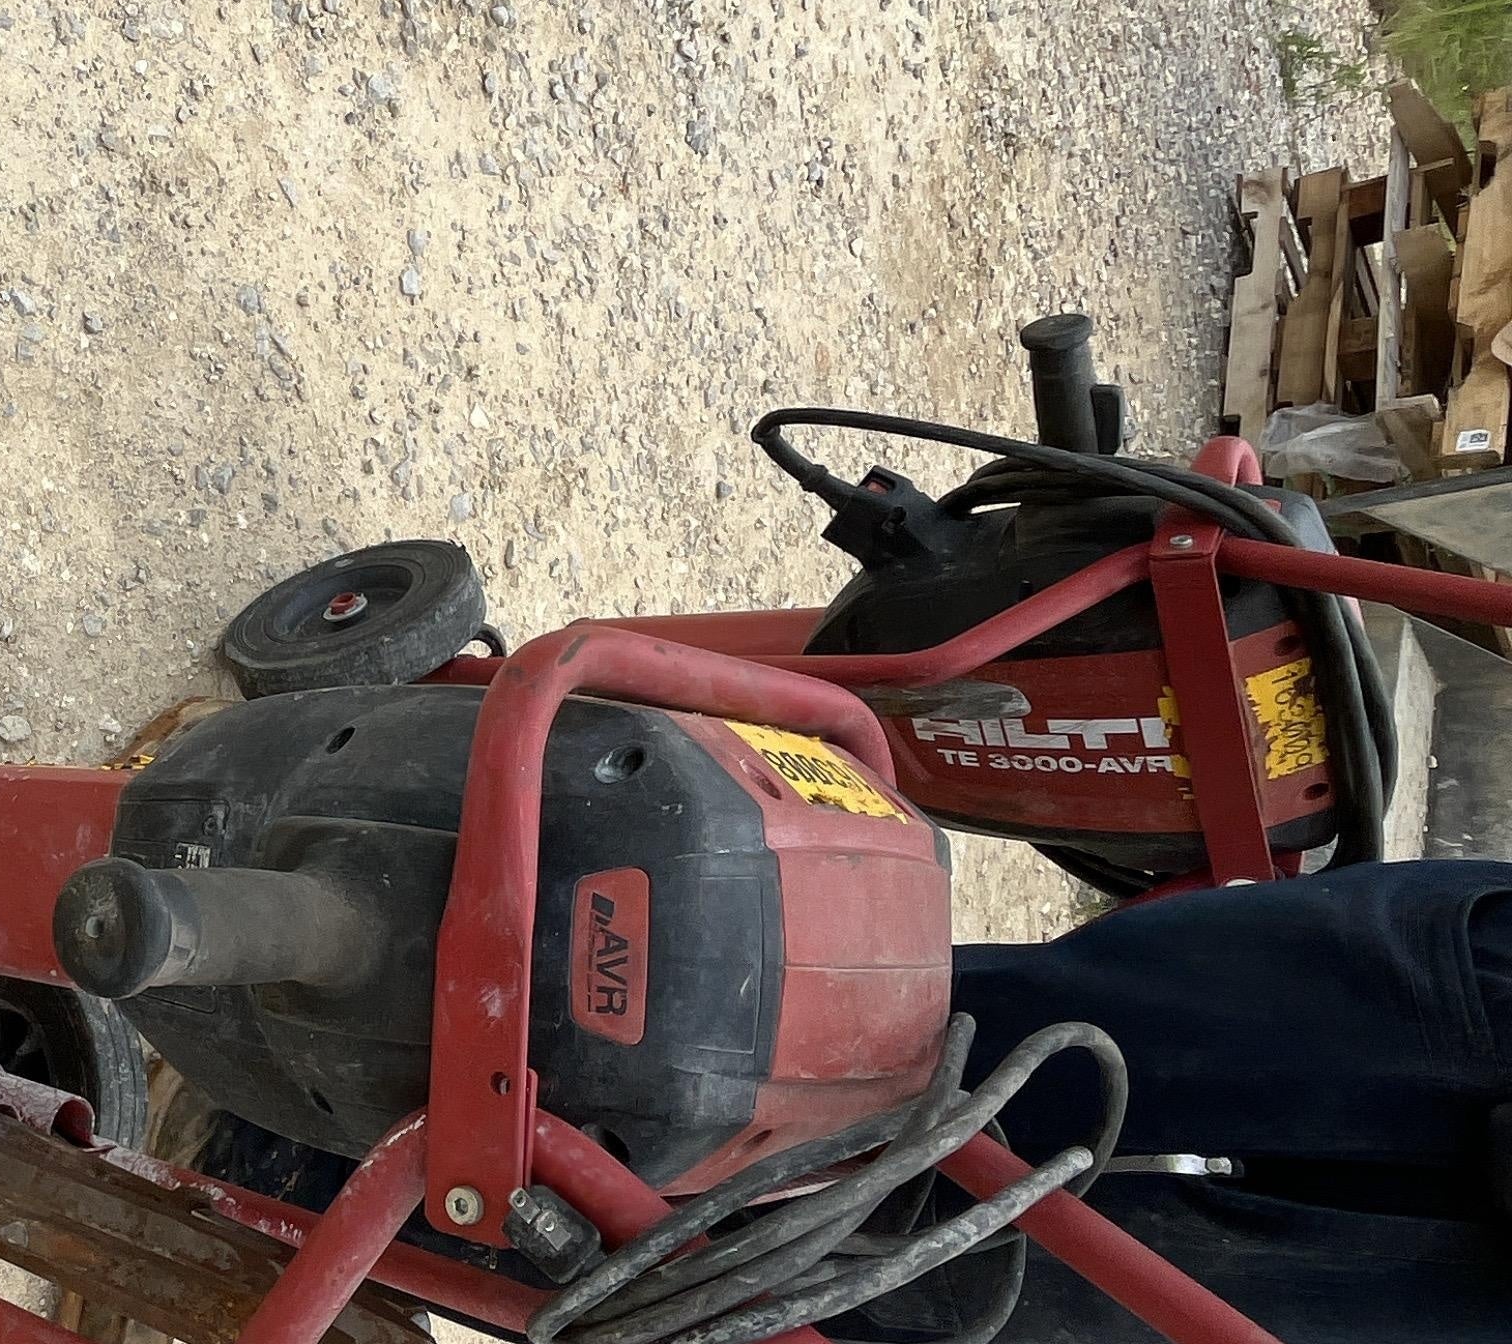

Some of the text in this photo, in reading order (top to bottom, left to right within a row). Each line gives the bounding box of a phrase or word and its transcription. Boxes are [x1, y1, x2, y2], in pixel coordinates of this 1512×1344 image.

[912, 717, 1169, 749] HILTI
[937, 749, 1174, 773] TE 3000-AVR
[595, 928, 628, 1016] AVR
